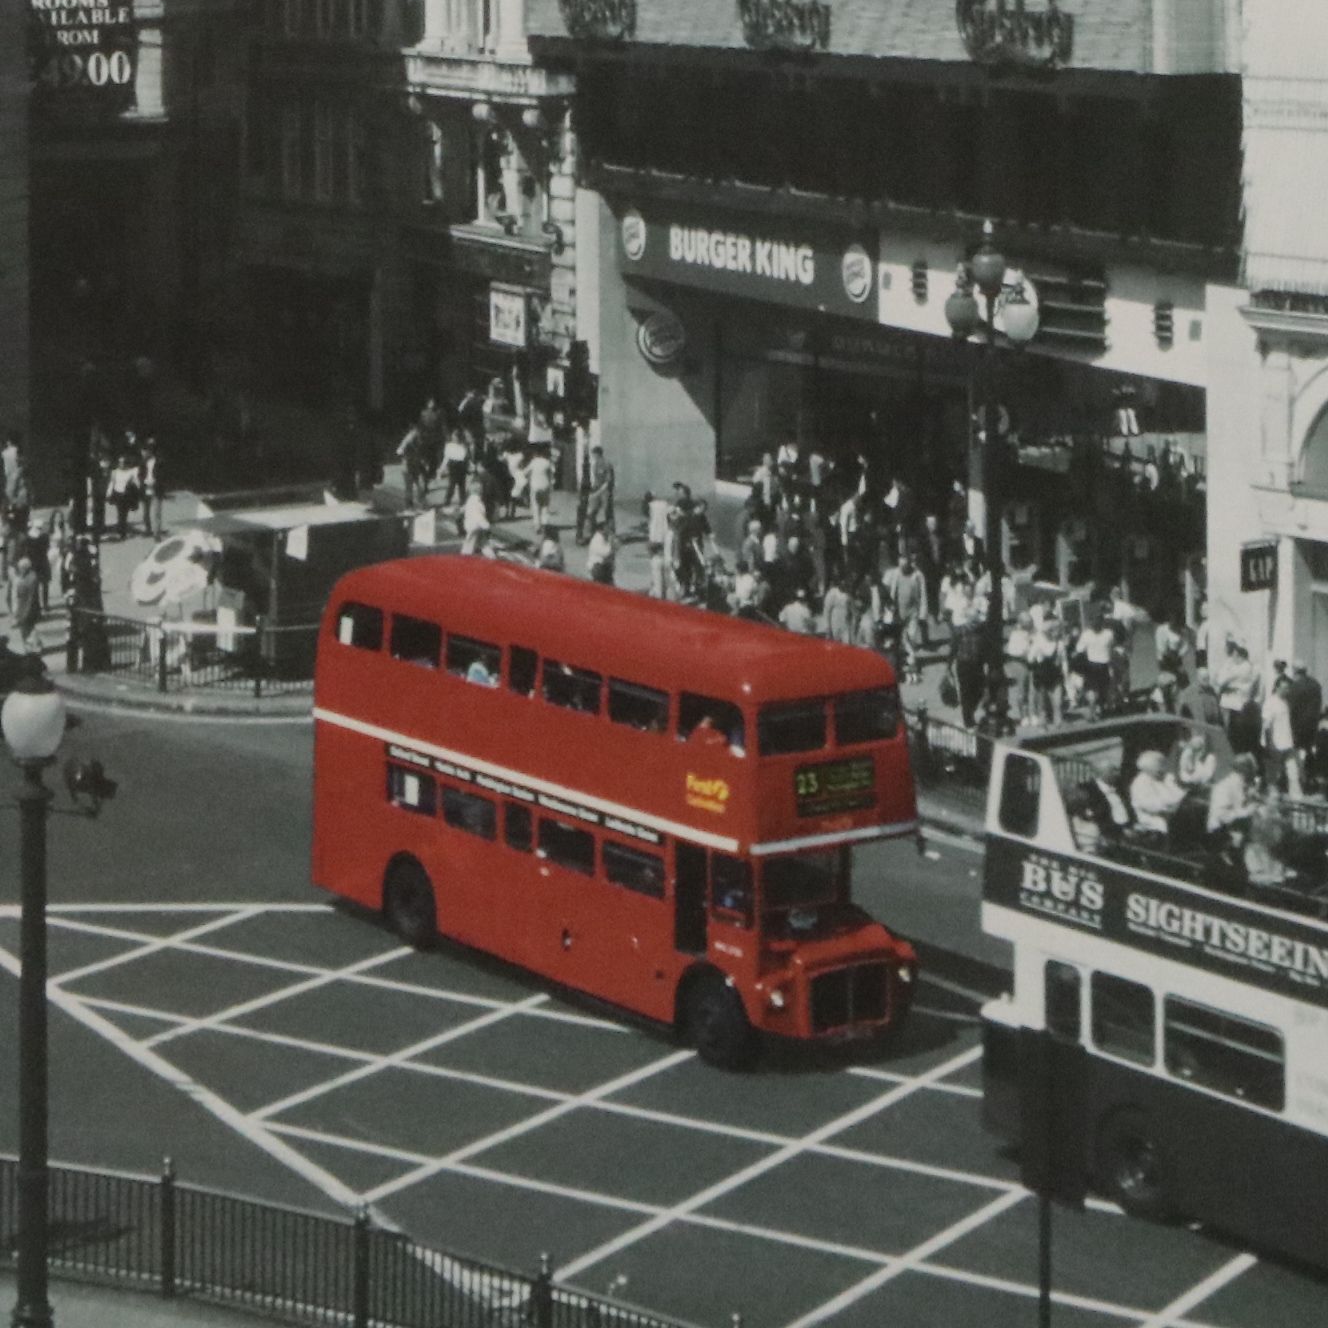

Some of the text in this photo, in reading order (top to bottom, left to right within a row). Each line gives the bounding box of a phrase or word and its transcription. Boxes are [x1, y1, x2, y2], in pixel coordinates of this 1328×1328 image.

[669, 224, 751, 273] BURGER
[755, 238, 815, 286] KING
[1021, 860, 1105, 912] BUS
